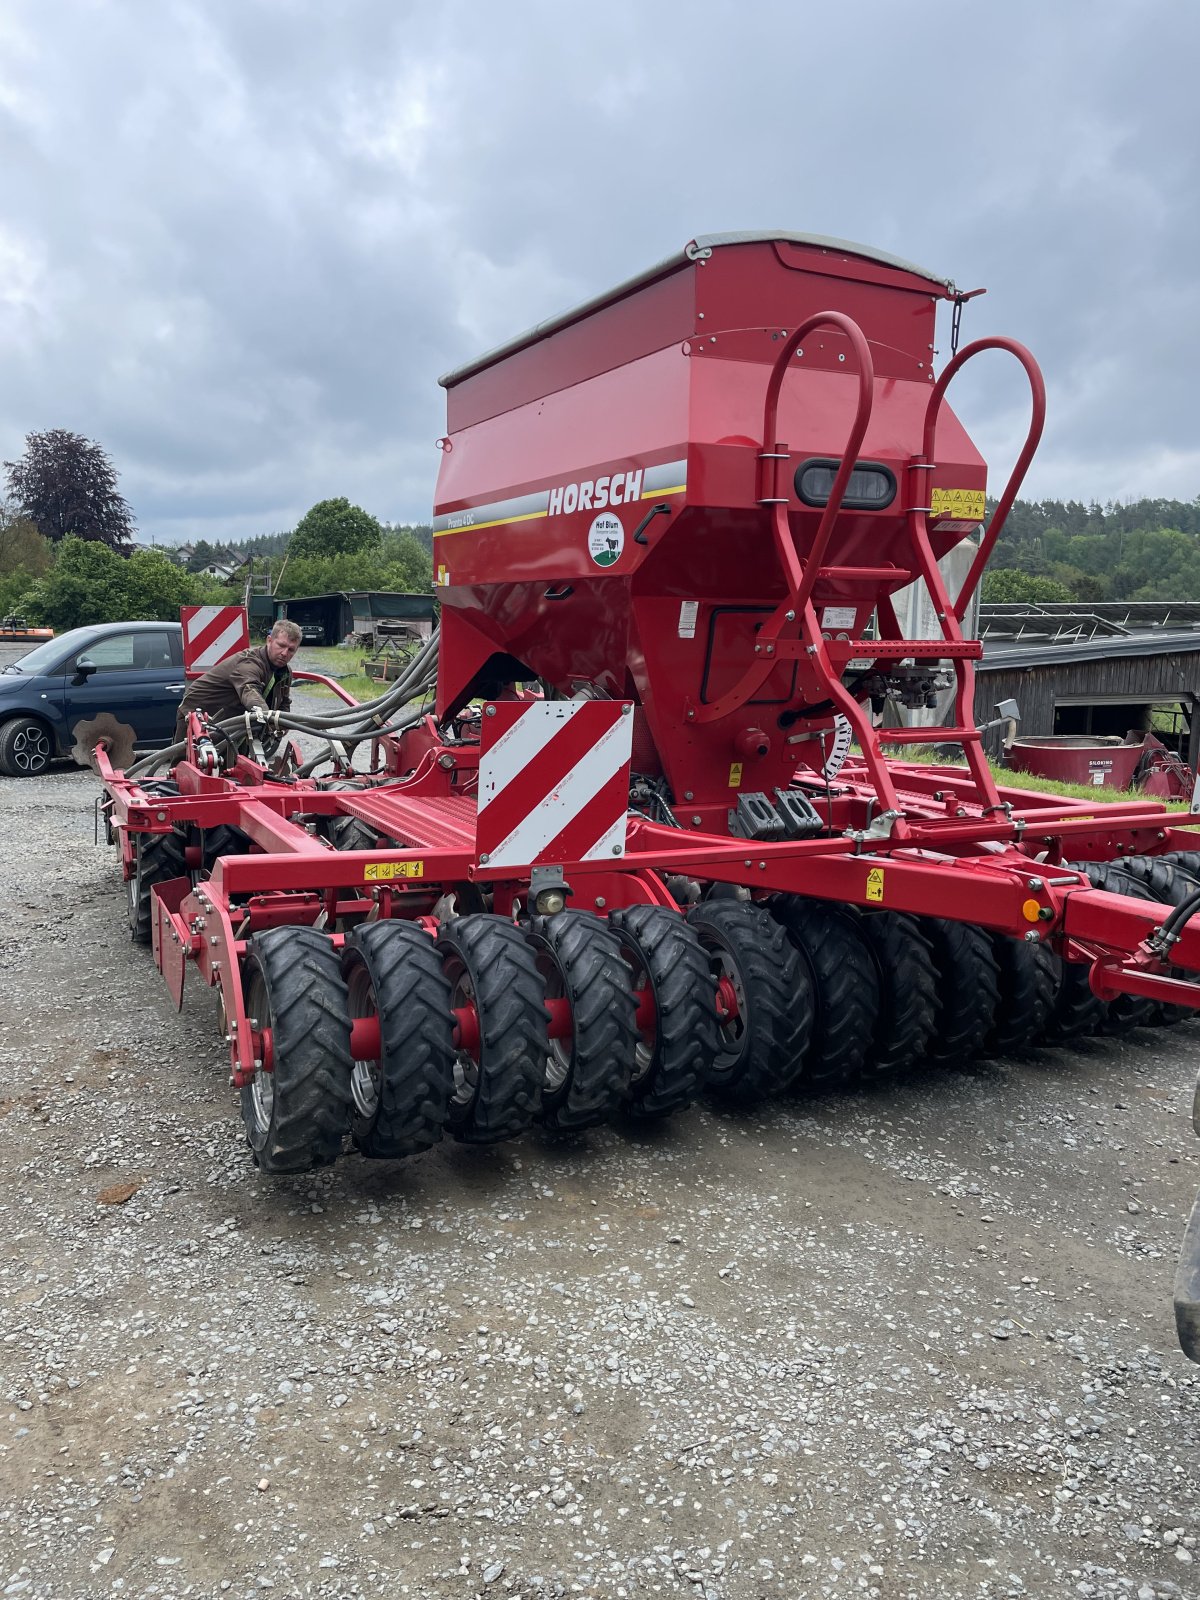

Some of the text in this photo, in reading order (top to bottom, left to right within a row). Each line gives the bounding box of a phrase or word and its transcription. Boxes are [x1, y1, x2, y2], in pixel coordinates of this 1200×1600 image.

[549, 469, 642, 516] HORSCH
[467, 513, 475, 525] DC
[596, 521, 619, 529] Hof Blum
